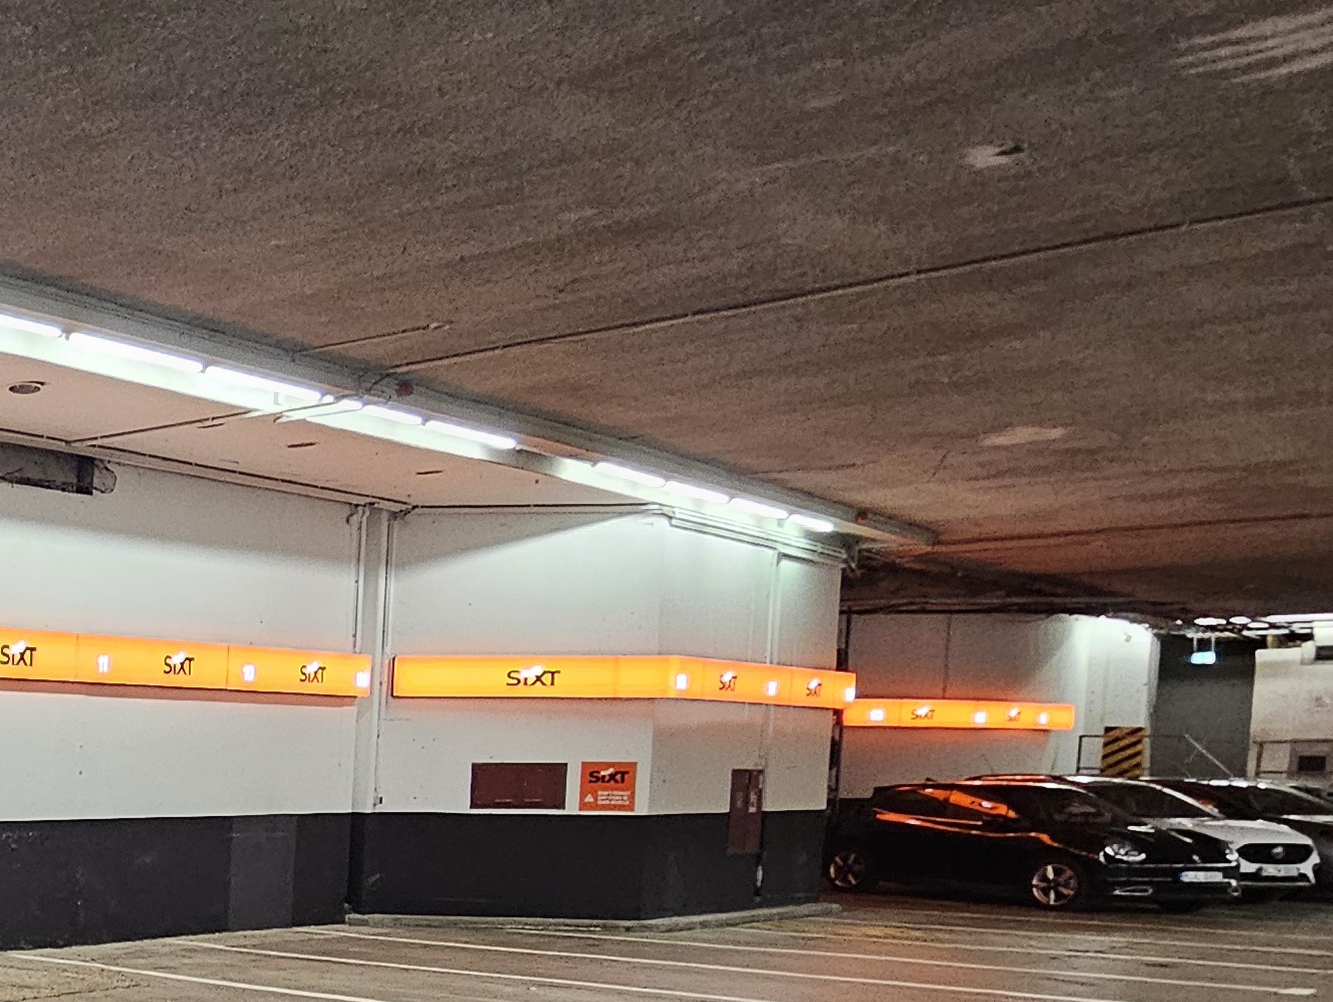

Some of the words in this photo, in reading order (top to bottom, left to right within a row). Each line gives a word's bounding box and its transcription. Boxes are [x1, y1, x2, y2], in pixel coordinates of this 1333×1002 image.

[0, 640, 37, 668] SIXT
[97, 653, 111, 674] 11
[163, 651, 195, 676] SIXT
[299, 661, 327, 684] SIXT
[506, 665, 561, 687] SIXT
[588, 767, 630, 784] SIXT
